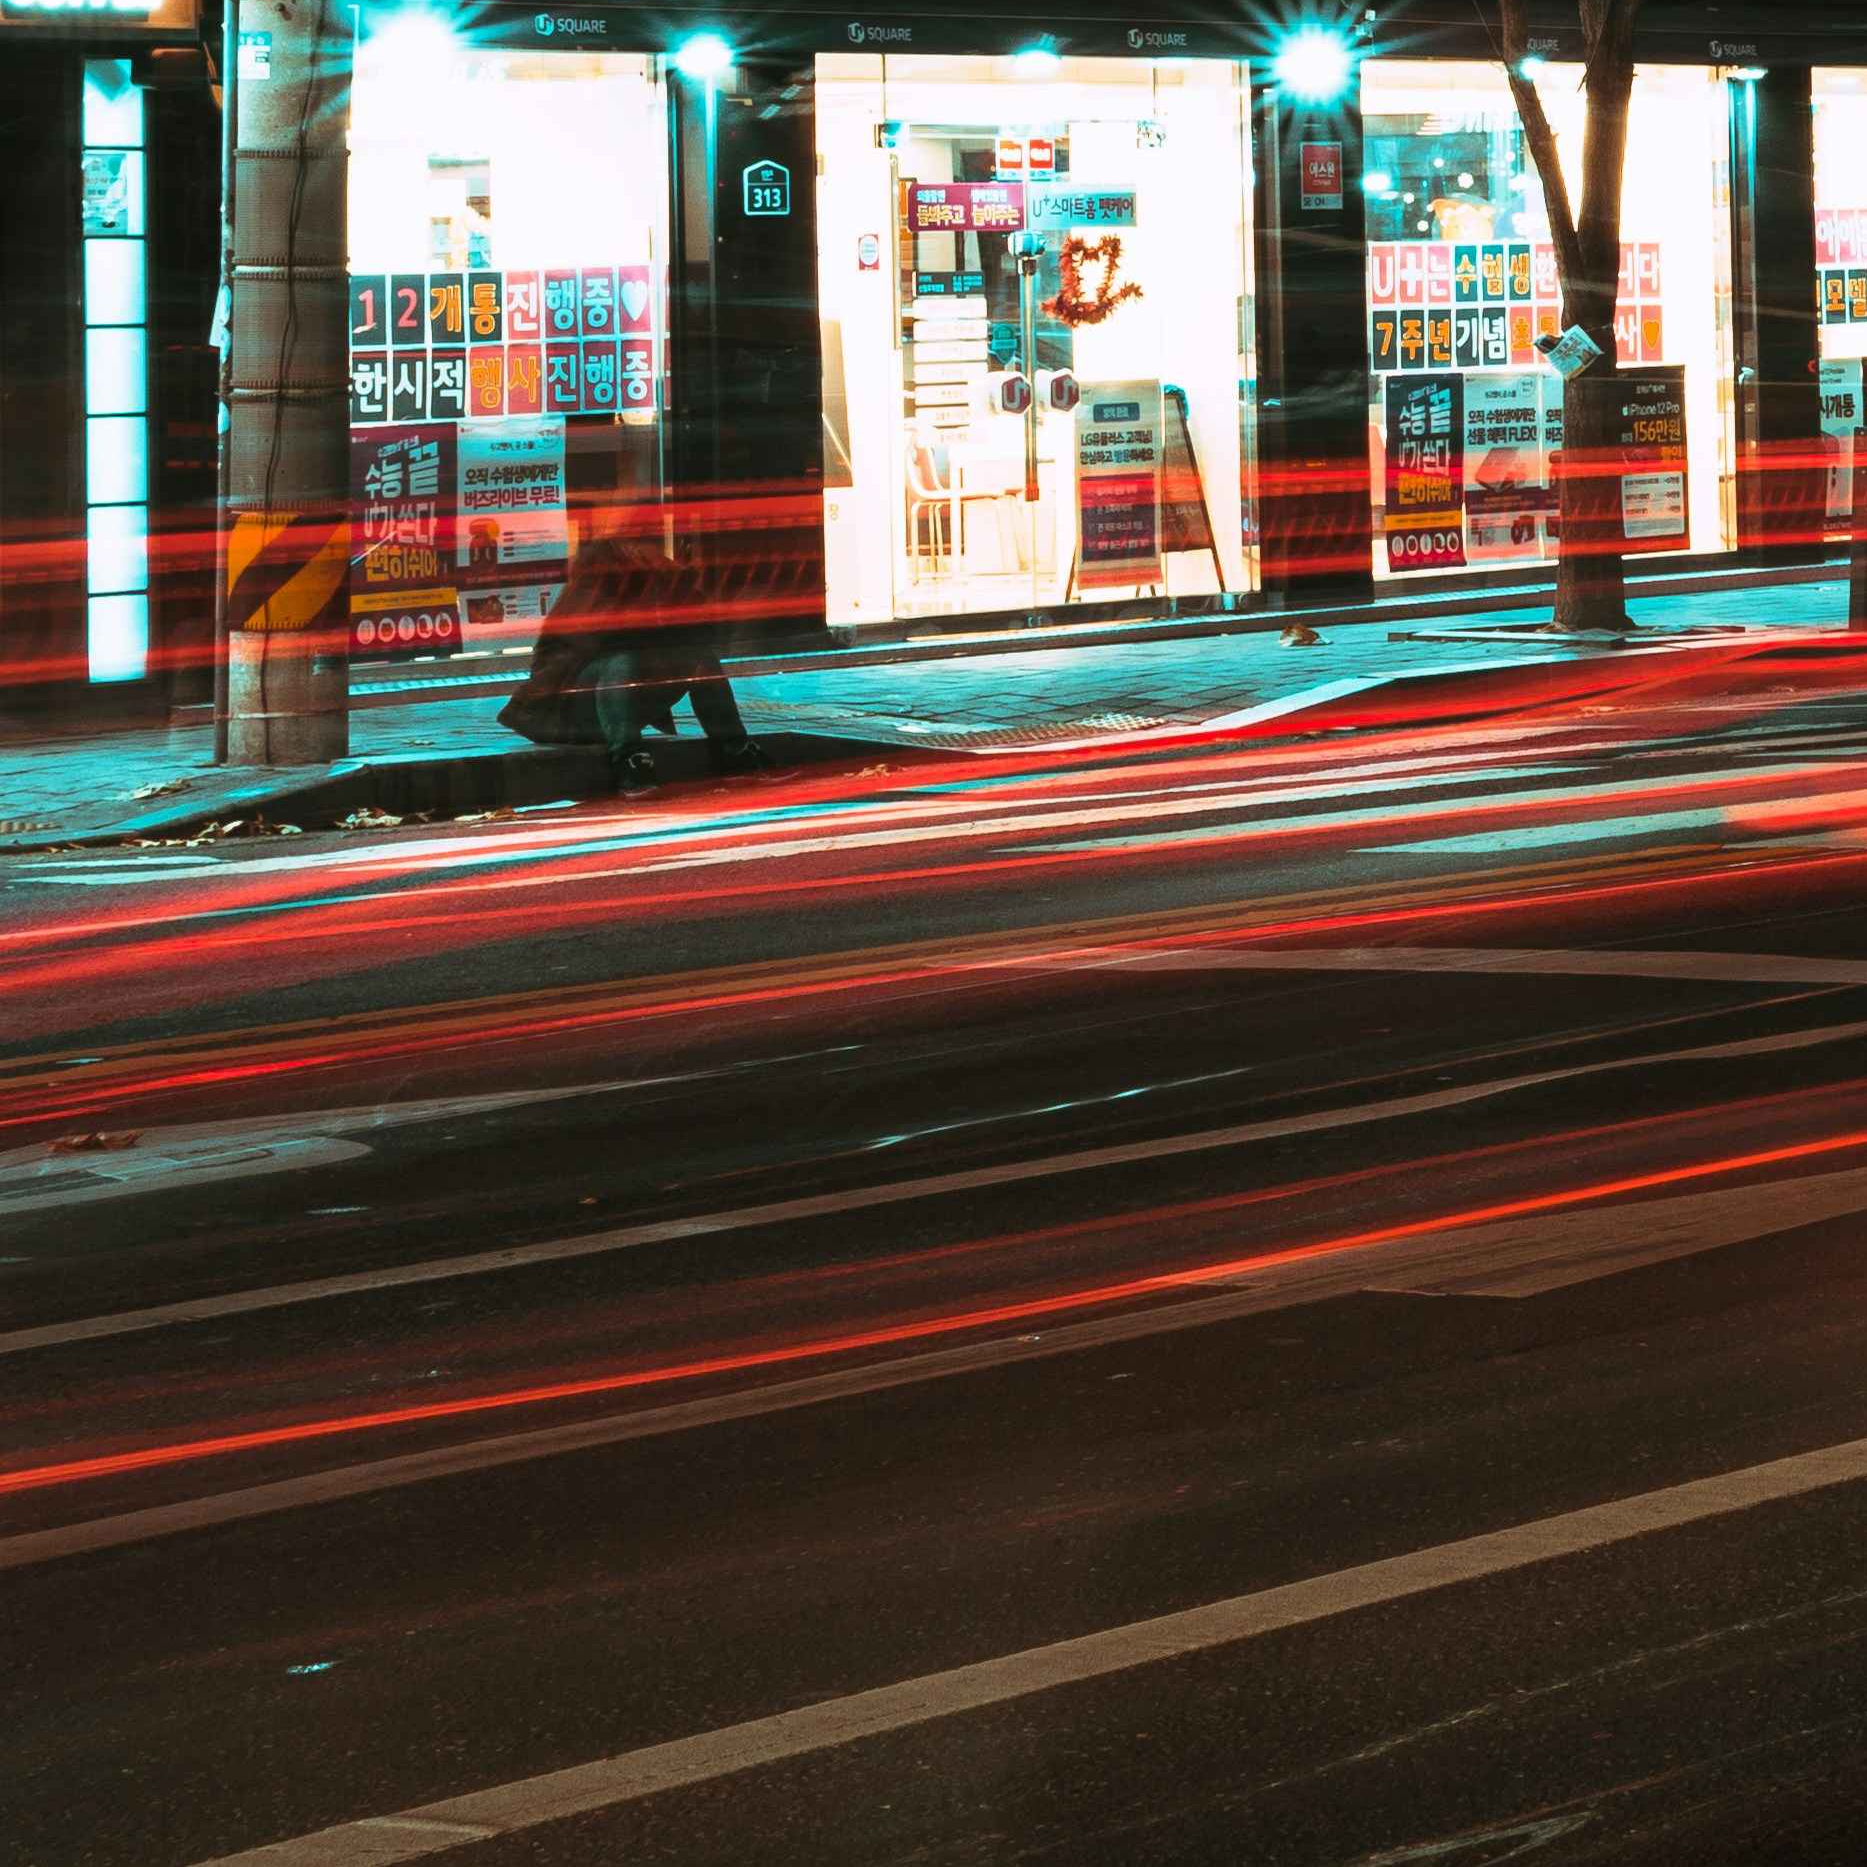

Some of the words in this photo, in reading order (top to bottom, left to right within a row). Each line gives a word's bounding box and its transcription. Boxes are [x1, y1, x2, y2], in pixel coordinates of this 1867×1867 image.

[557, 17, 607, 35] SQUARE
[867, 27, 912, 43] SQUARE
[1145, 31, 1187, 47] SQUARE
[1723, 43, 1758, 57] SQUARE
[752, 188, 782, 209] 313
[1629, 405, 1657, 417] iPhone
[1667, 402, 1680, 414] Pro
[1633, 418, 1682, 443] 156만원
